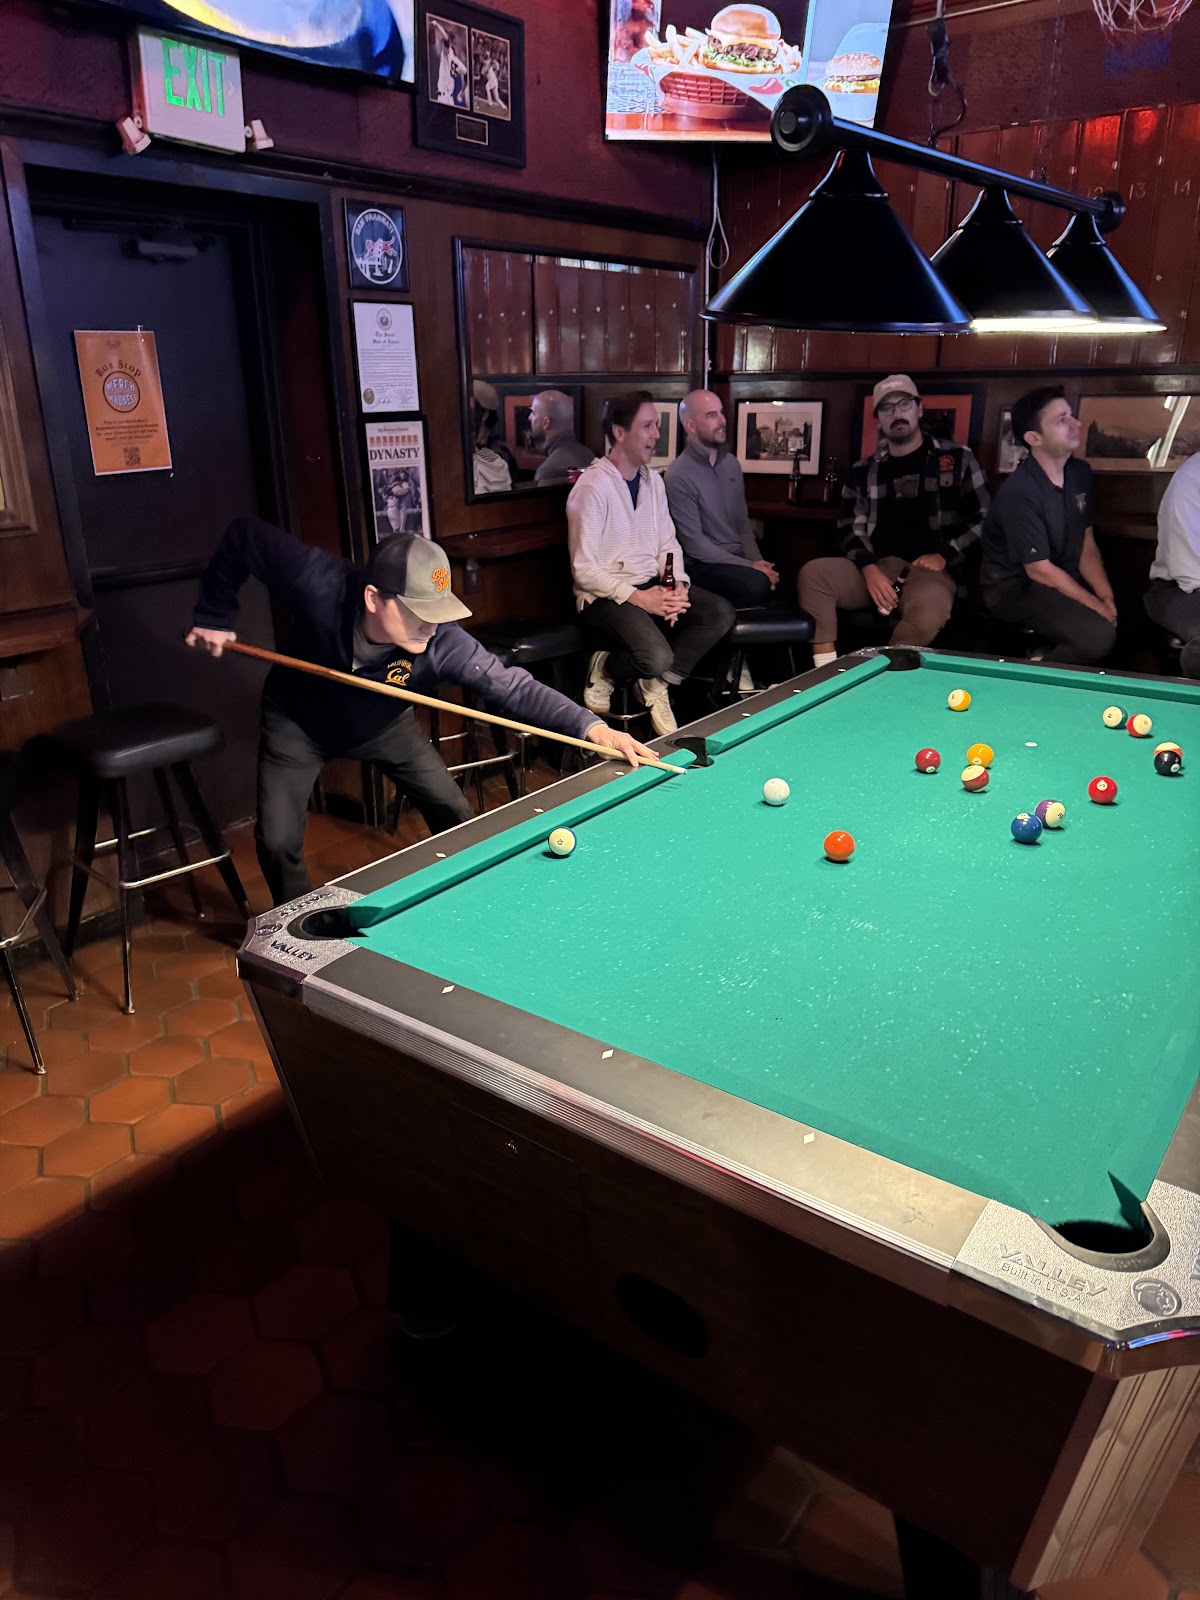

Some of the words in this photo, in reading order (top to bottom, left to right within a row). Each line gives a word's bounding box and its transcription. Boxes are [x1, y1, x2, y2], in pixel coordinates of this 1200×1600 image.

[161, 37, 226, 116] EXIT
[1129, 182, 1146, 200] 13
[1174, 179, 1191, 196] 14
[118, 360, 142, 377] Stop
[106, 378, 135, 393] MERCH
[369, 447, 420, 460] DYNASTY
[385, 668, 410, 685] Cal
[270, 939, 318, 961] VALLEY
[999, 1243, 1107, 1296] VALLEY
[1001, 1262, 1028, 1280] Built
[1030, 1275, 1042, 1286] in
